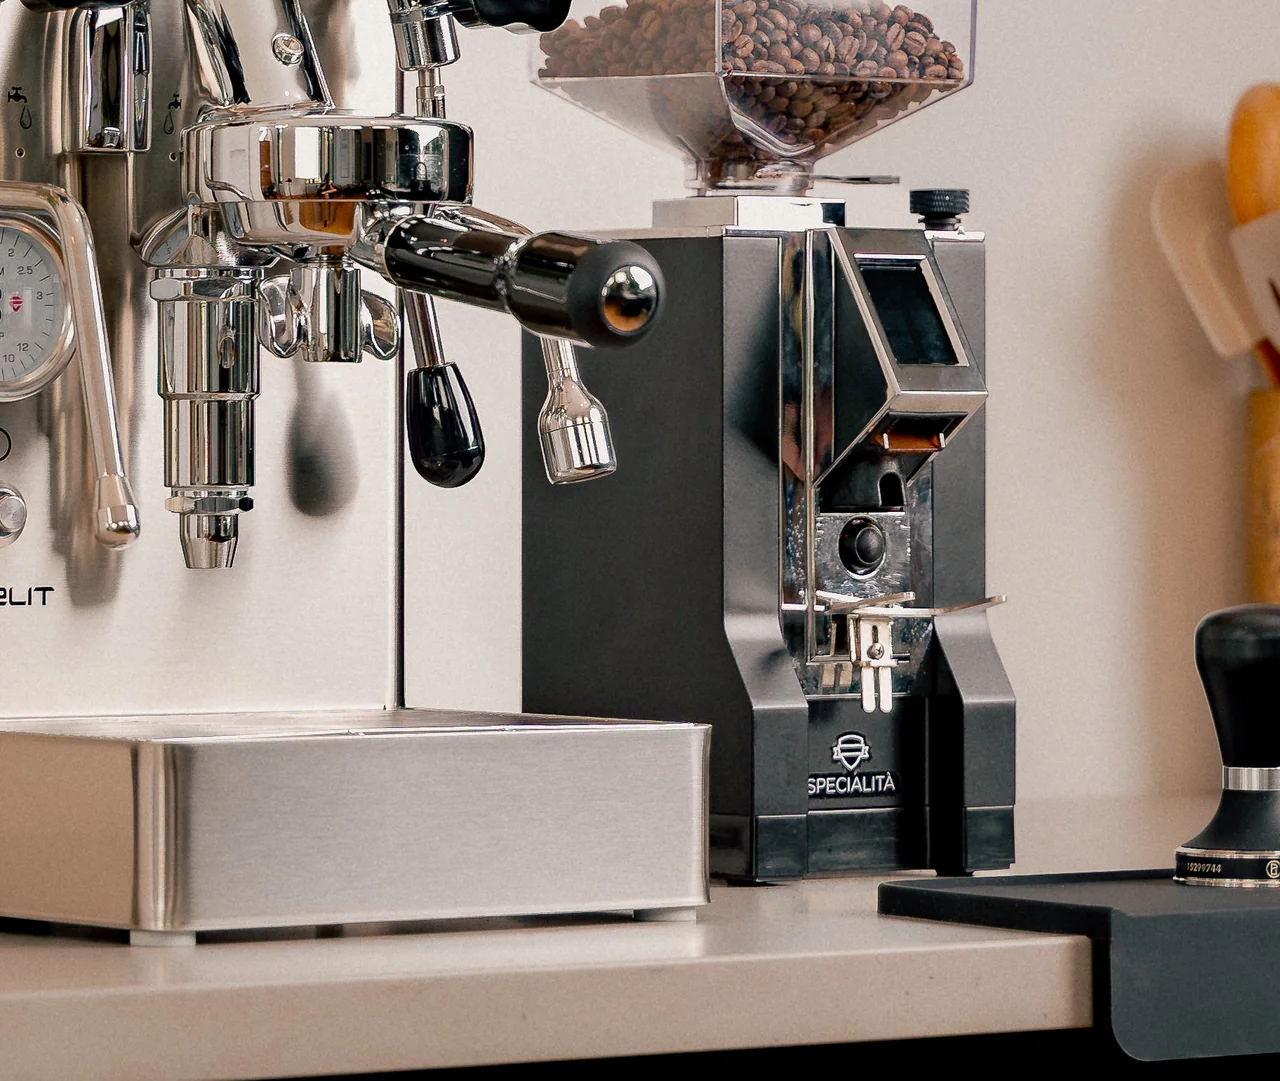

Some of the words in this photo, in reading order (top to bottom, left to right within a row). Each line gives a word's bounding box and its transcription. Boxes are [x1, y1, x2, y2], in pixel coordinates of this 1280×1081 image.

[7, 248, 15, 258] 2
[17, 265, 33, 275] 2.5
[36, 291, 43, 300] 3
[17, 342, 29, 352] 12
[3, 353, 15, 363] 10
[807, 771, 896, 795] SPECIALITÀ
